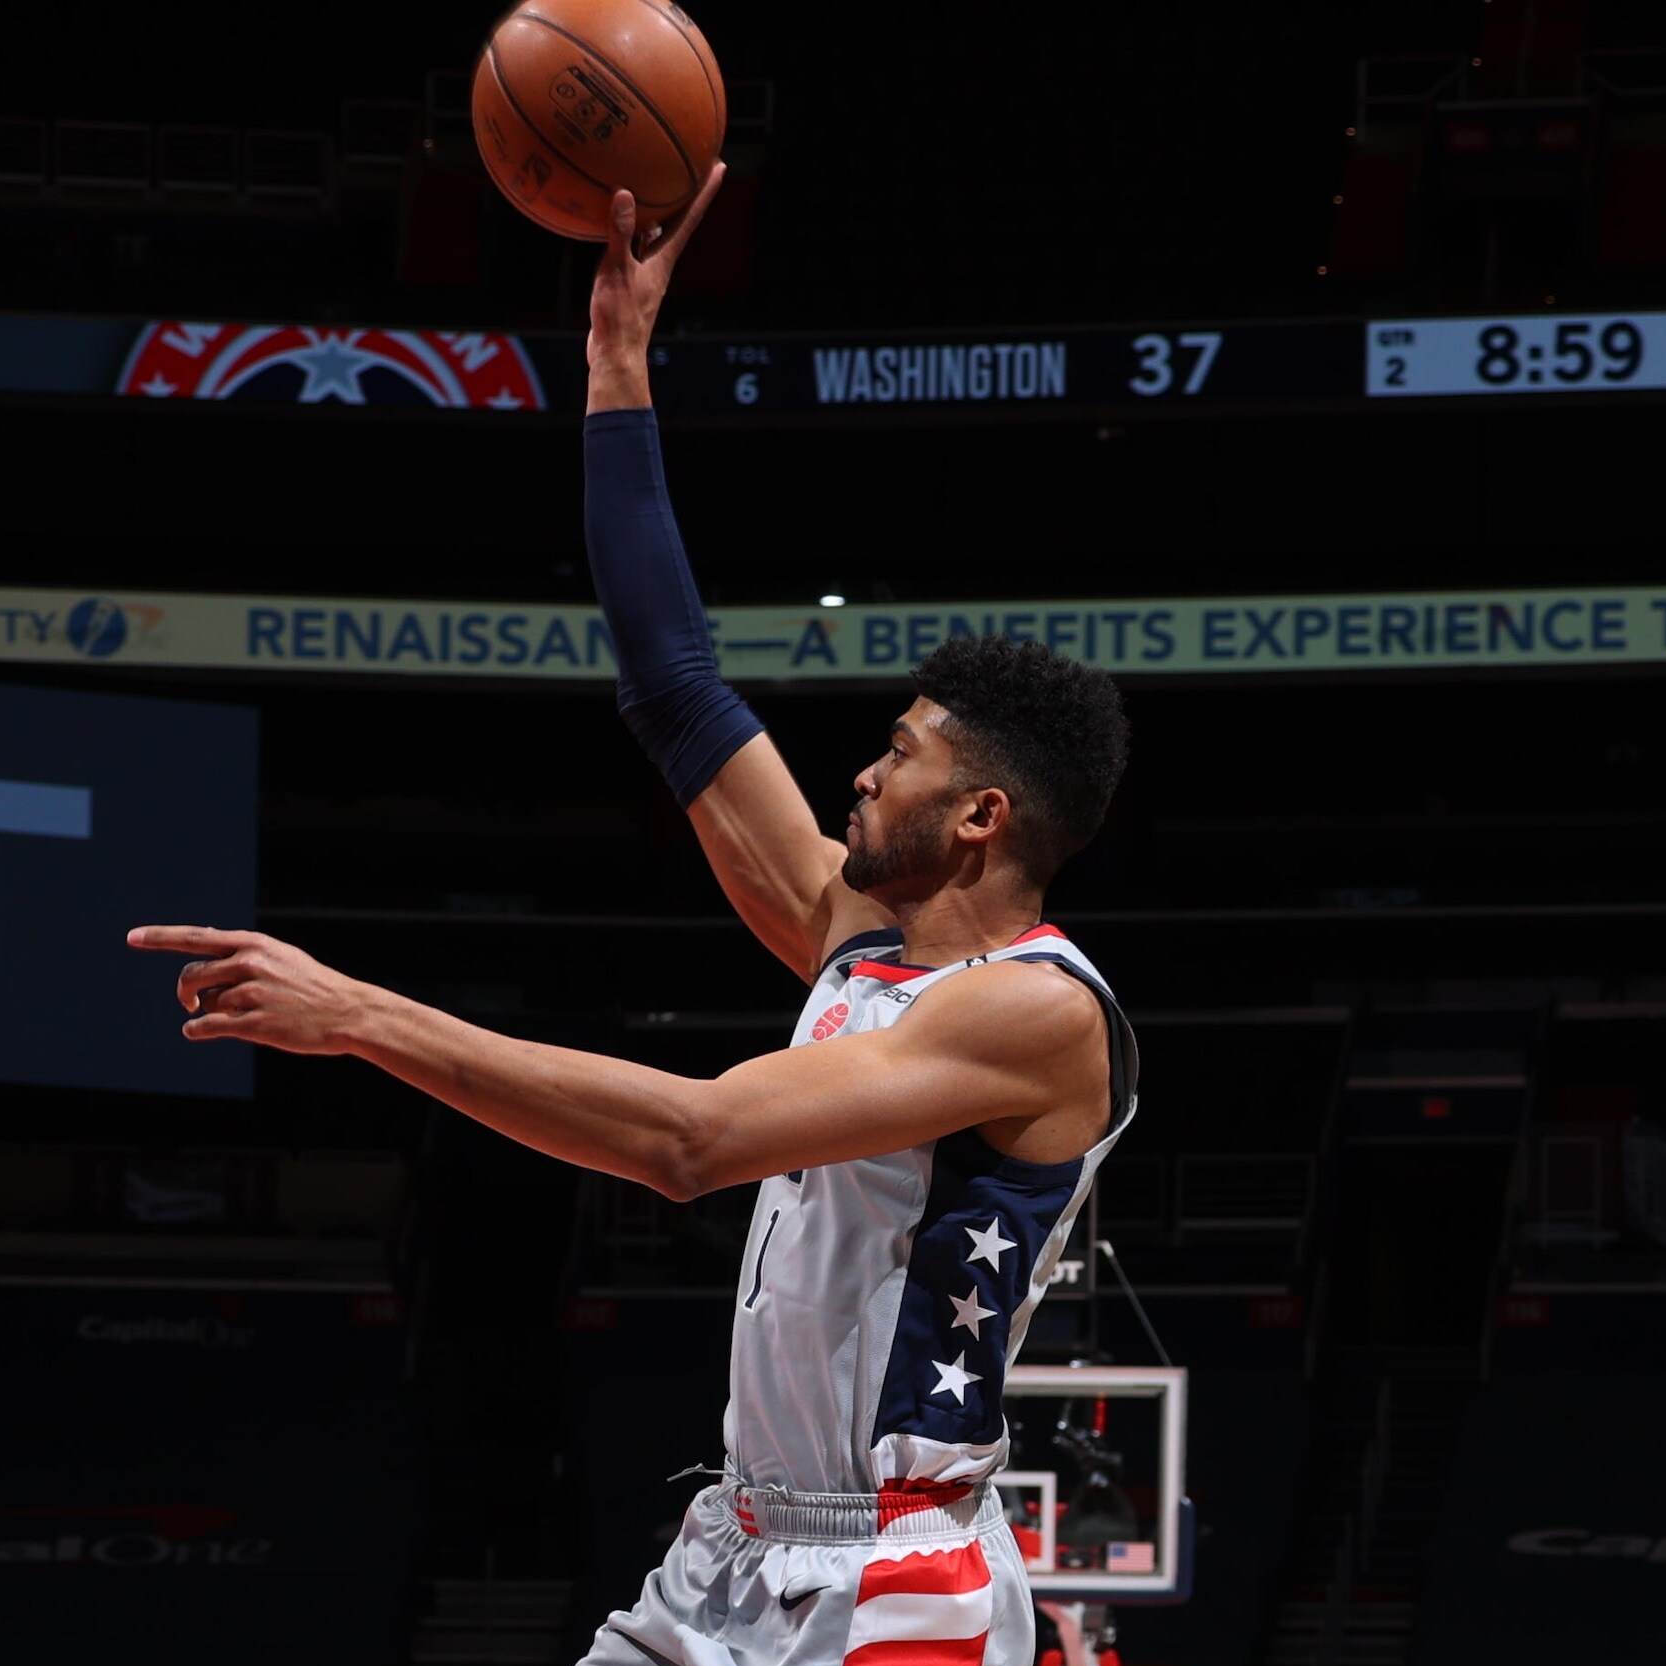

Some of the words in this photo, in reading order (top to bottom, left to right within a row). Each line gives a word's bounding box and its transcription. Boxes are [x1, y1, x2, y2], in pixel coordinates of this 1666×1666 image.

[725, 345, 773, 366] TOL
[813, 341, 1068, 406] WASHINGTON
[1128, 331, 1225, 397] 37
[1475, 322, 1644, 384] 8:59
[734, 372, 760, 405] 6
[1385, 358, 1406, 387] 2
[1203, 600, 1627, 660] EXPERIENCE
